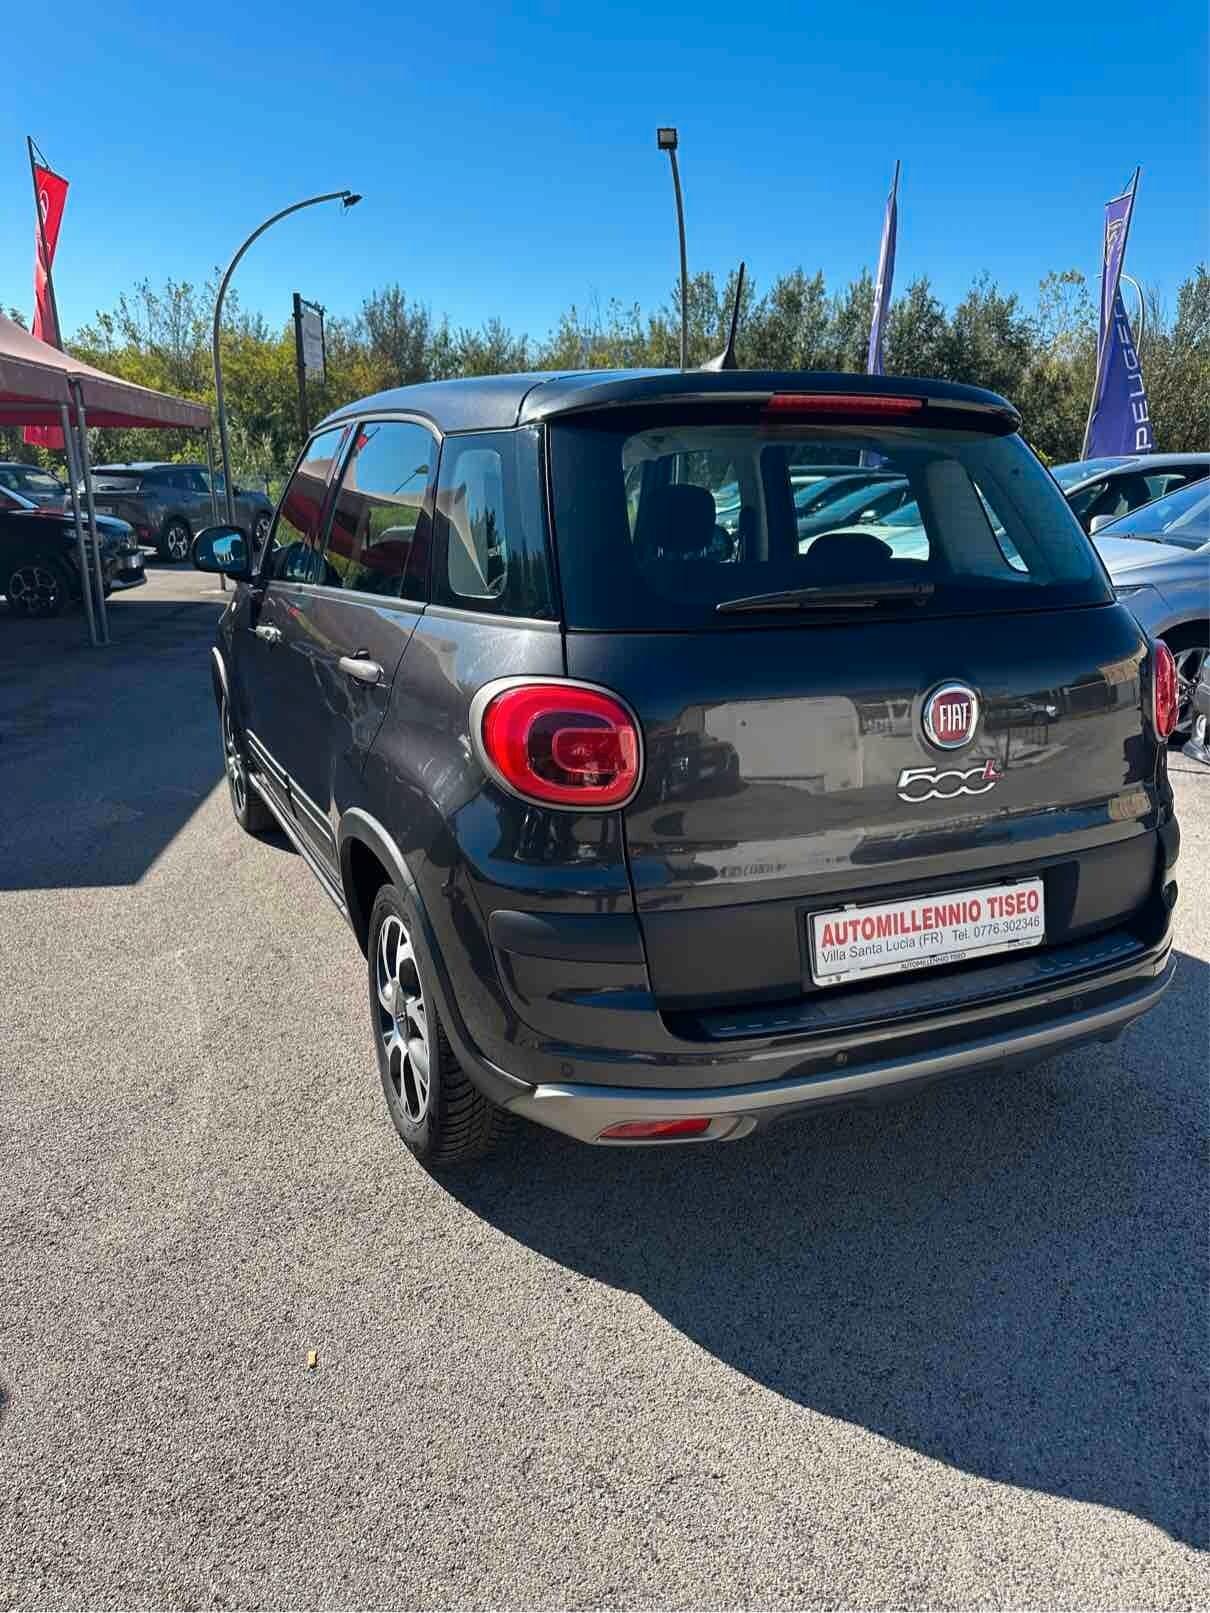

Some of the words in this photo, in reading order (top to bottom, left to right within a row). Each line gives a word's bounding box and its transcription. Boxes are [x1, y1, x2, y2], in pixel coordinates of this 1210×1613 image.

[1114, 296, 1152, 450] PEUGE
[938, 702, 968, 733] FIAT
[821, 899, 981, 948] AUTOMILLENNIO
[986, 889, 1039, 919] TISEO
[822, 948, 846, 963] Villa
[849, 943, 883, 958] Santa
[886, 937, 916, 952] Lucia
[919, 930, 944, 950] (FR)
[952, 928, 970, 942] Tel.
[974, 915, 1040, 938] 0776.302346
